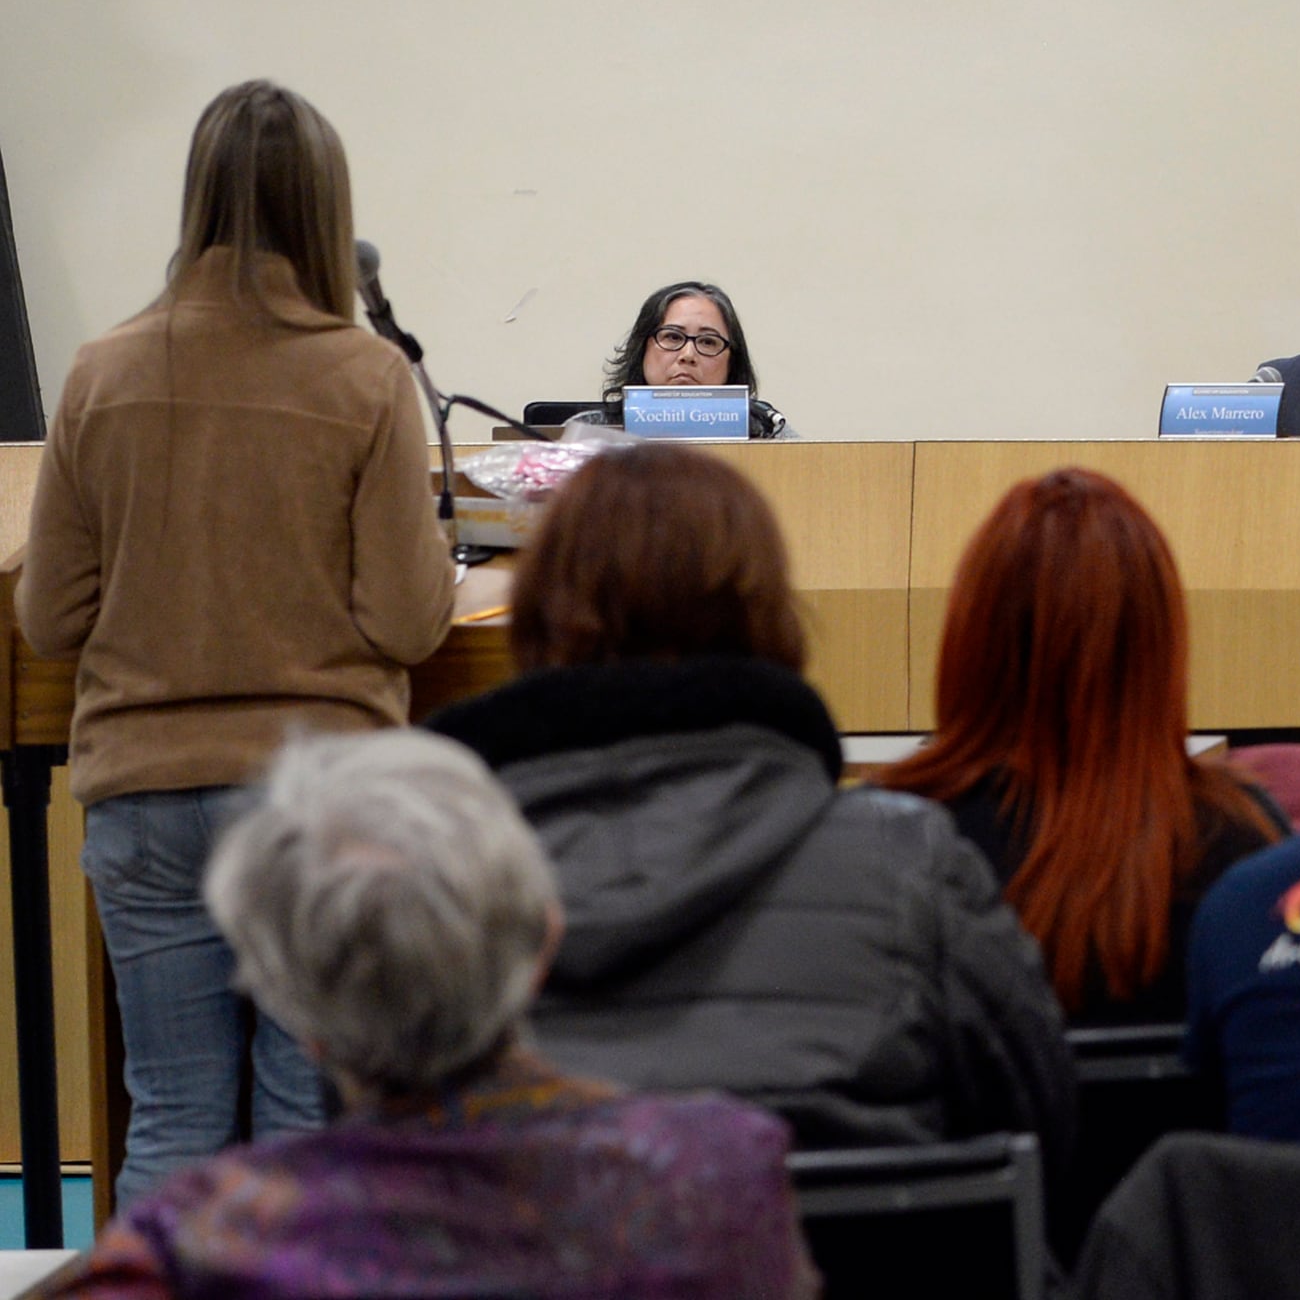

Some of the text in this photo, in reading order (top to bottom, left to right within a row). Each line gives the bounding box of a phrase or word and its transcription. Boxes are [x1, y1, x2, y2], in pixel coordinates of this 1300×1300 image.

[634, 409, 740, 425] Xochitl Gaytan
[1175, 406, 1265, 420] Alex Marrero
